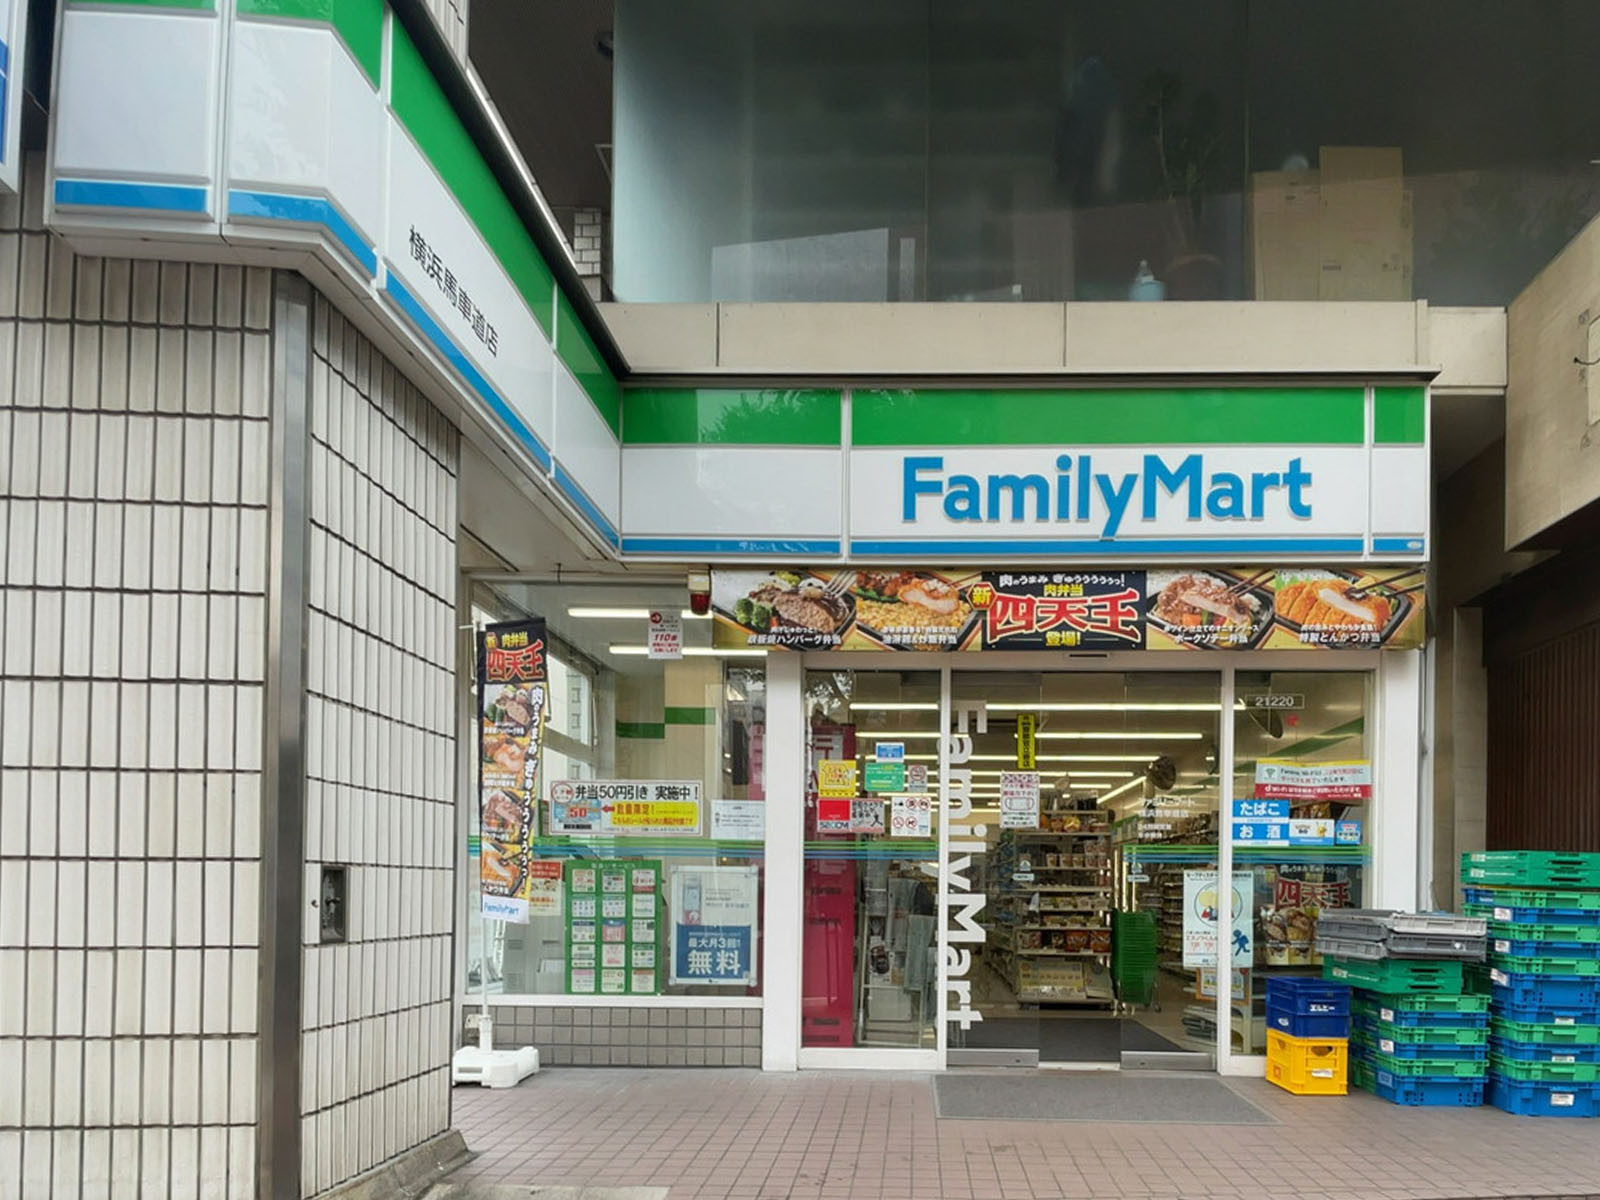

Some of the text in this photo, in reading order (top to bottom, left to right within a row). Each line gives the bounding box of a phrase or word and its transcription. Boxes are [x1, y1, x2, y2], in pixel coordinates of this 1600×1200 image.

[409, 225, 498, 357] 横浜馬車道店
[903, 454, 1312, 541] FamilyMart
[999, 575, 1048, 587] 肉のうまみ
[1043, 584, 1083, 597] 肉弁当
[972, 586, 993, 605] 新
[988, 589, 1142, 643] 四天王
[502, 632, 528, 648] 肉弁当
[486, 639, 545, 681] 四天王
[1256, 695, 1294, 707] 21220
[575, 785, 648, 800] 弁当50円引き
[655, 785, 699, 800] 実施中！
[1240, 802, 1285, 816] たばこ
[921, 700, 988, 1031] FamilyMart
[1275, 879, 1351, 912] 四天王
[688, 950, 741, 975] 無料
